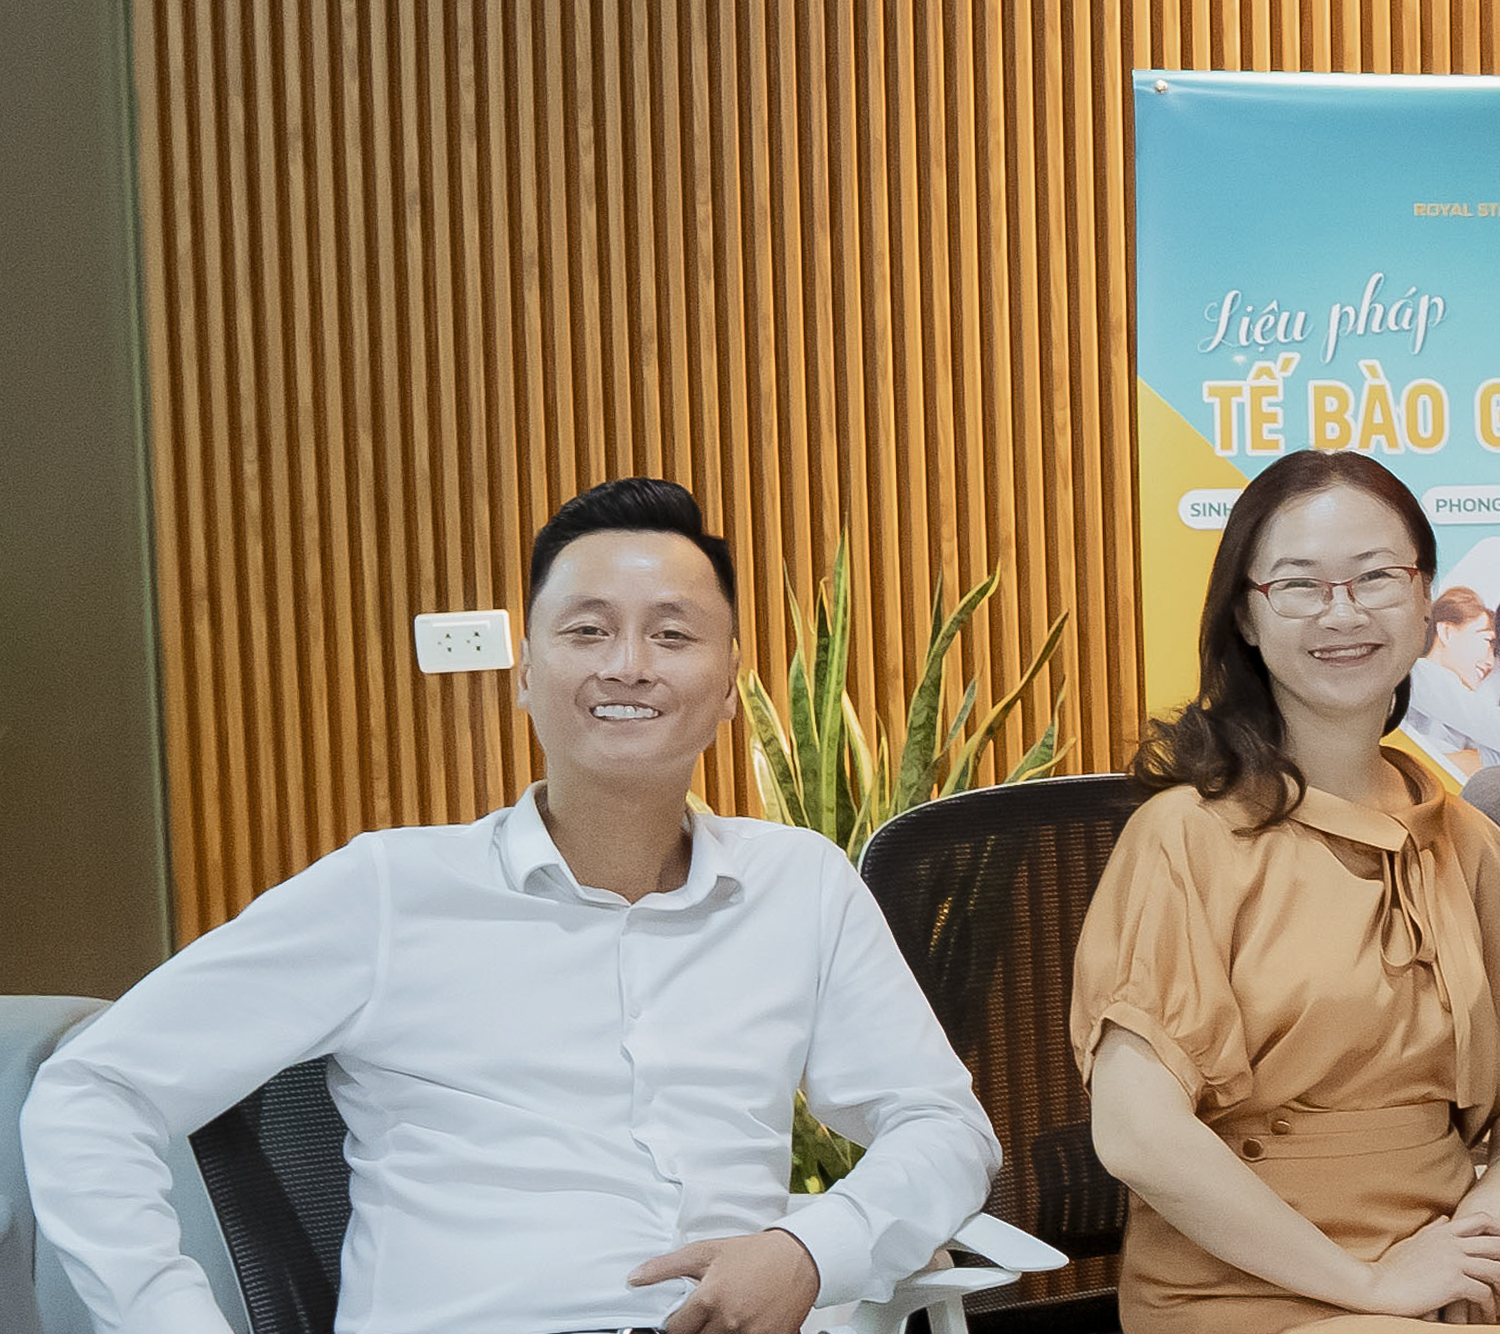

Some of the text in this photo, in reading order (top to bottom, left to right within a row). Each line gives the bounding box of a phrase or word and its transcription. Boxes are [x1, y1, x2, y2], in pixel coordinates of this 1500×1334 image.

[1413, 203, 1474, 217] ROYAL
[1198, 272, 1448, 364] Liệu pháp
[1202, 352, 1300, 456] TẾ
[1307, 359, 1449, 455] BÀO
